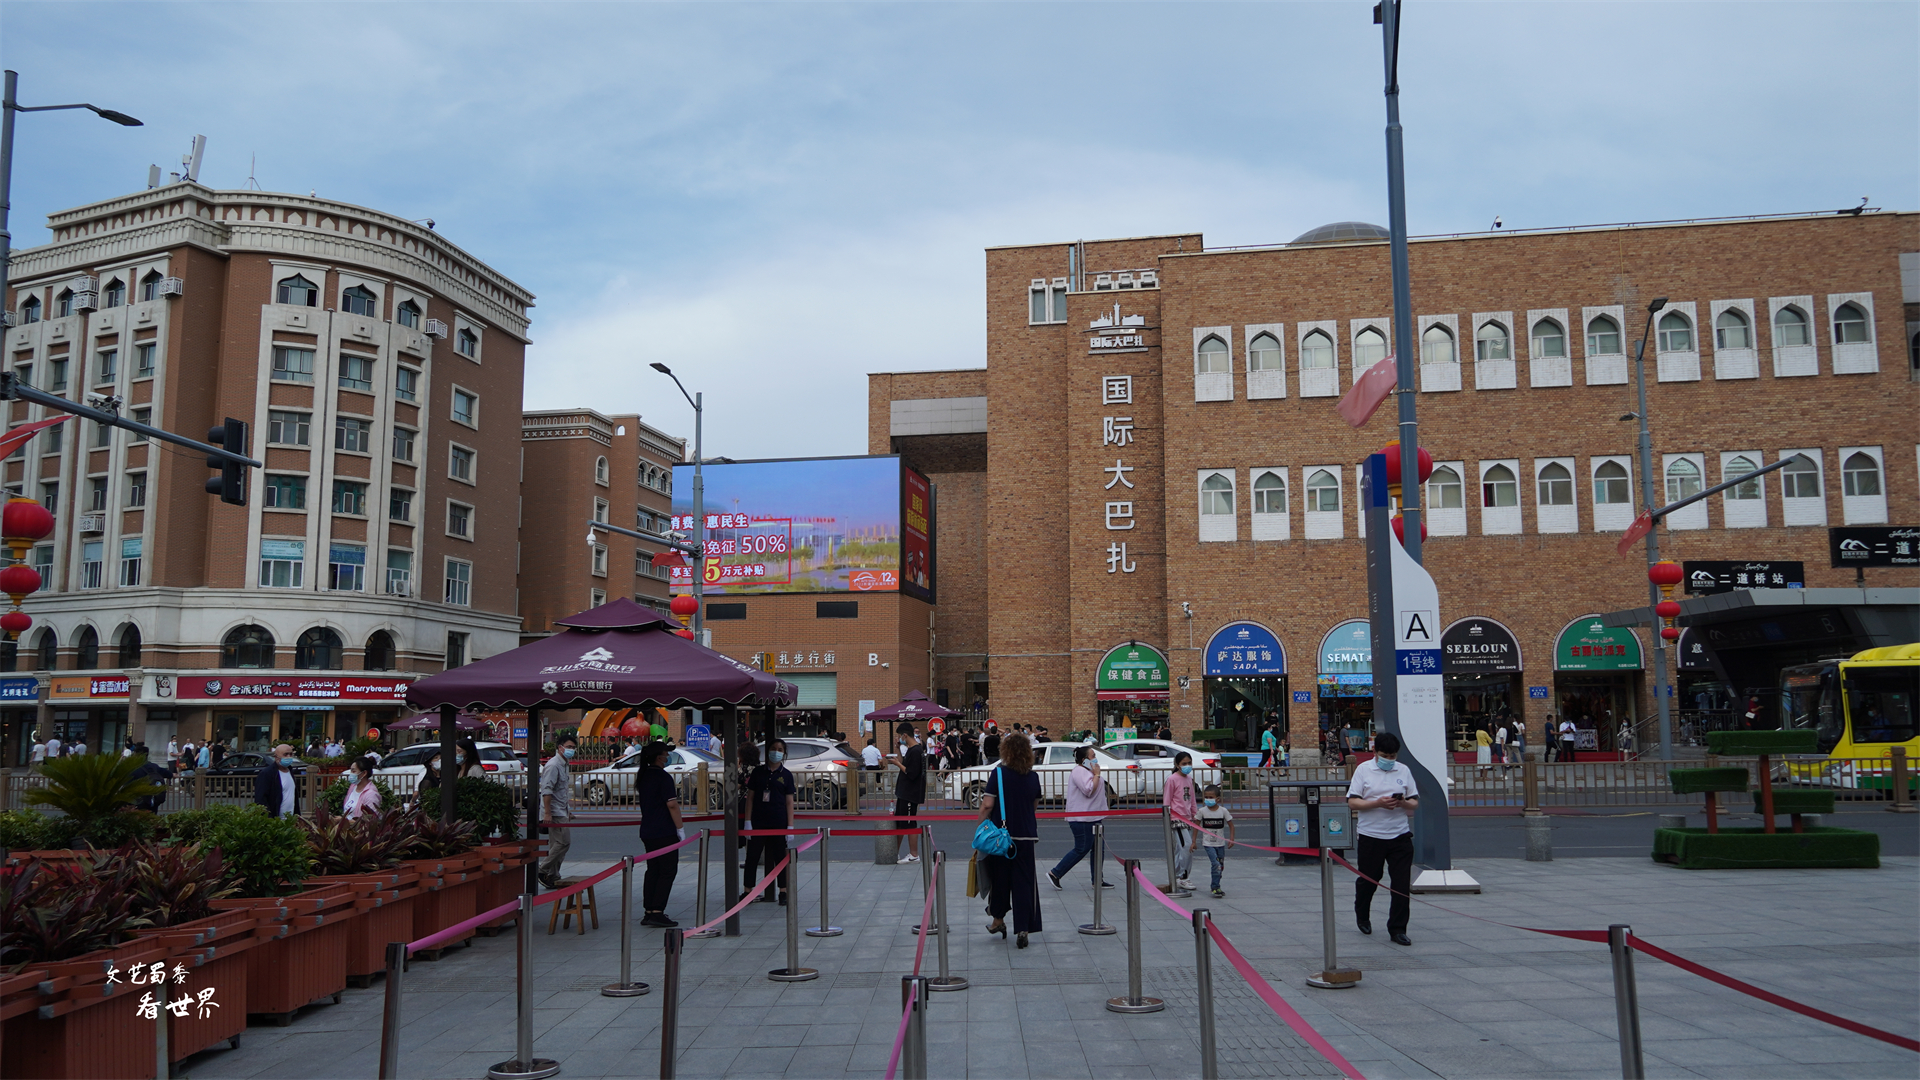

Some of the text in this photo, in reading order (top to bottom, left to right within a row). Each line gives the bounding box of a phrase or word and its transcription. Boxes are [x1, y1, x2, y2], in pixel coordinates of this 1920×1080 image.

[1090, 335, 1144, 348] 国际大巴扎
[1102, 375, 1136, 574] 国际大巴扎
[706, 514, 748, 529] 惠民生
[742, 535, 786, 554] 50%
[1874, 541, 1920, 555] 二道
[1719, 573, 1784, 584] 二道桥站
[1405, 613, 1430, 640] A
[1446, 643, 1508, 654] SEELOUN
[1571, 644, 1626, 656] 古丽怡派克
[751, 653, 836, 665] 大扎步行街
[868, 653, 879, 666] B
[1218, 650, 1272, 662] 萨达服饰
[1327, 653, 1365, 663] SEMAT
[1402, 656, 1436, 669] 1号线
[1107, 669, 1161, 680] 保健食品
[229, 684, 272, 696] 金派利尔
[346, 684, 393, 693] Marrybrown
[562, 681, 613, 690] 天山农商银行
